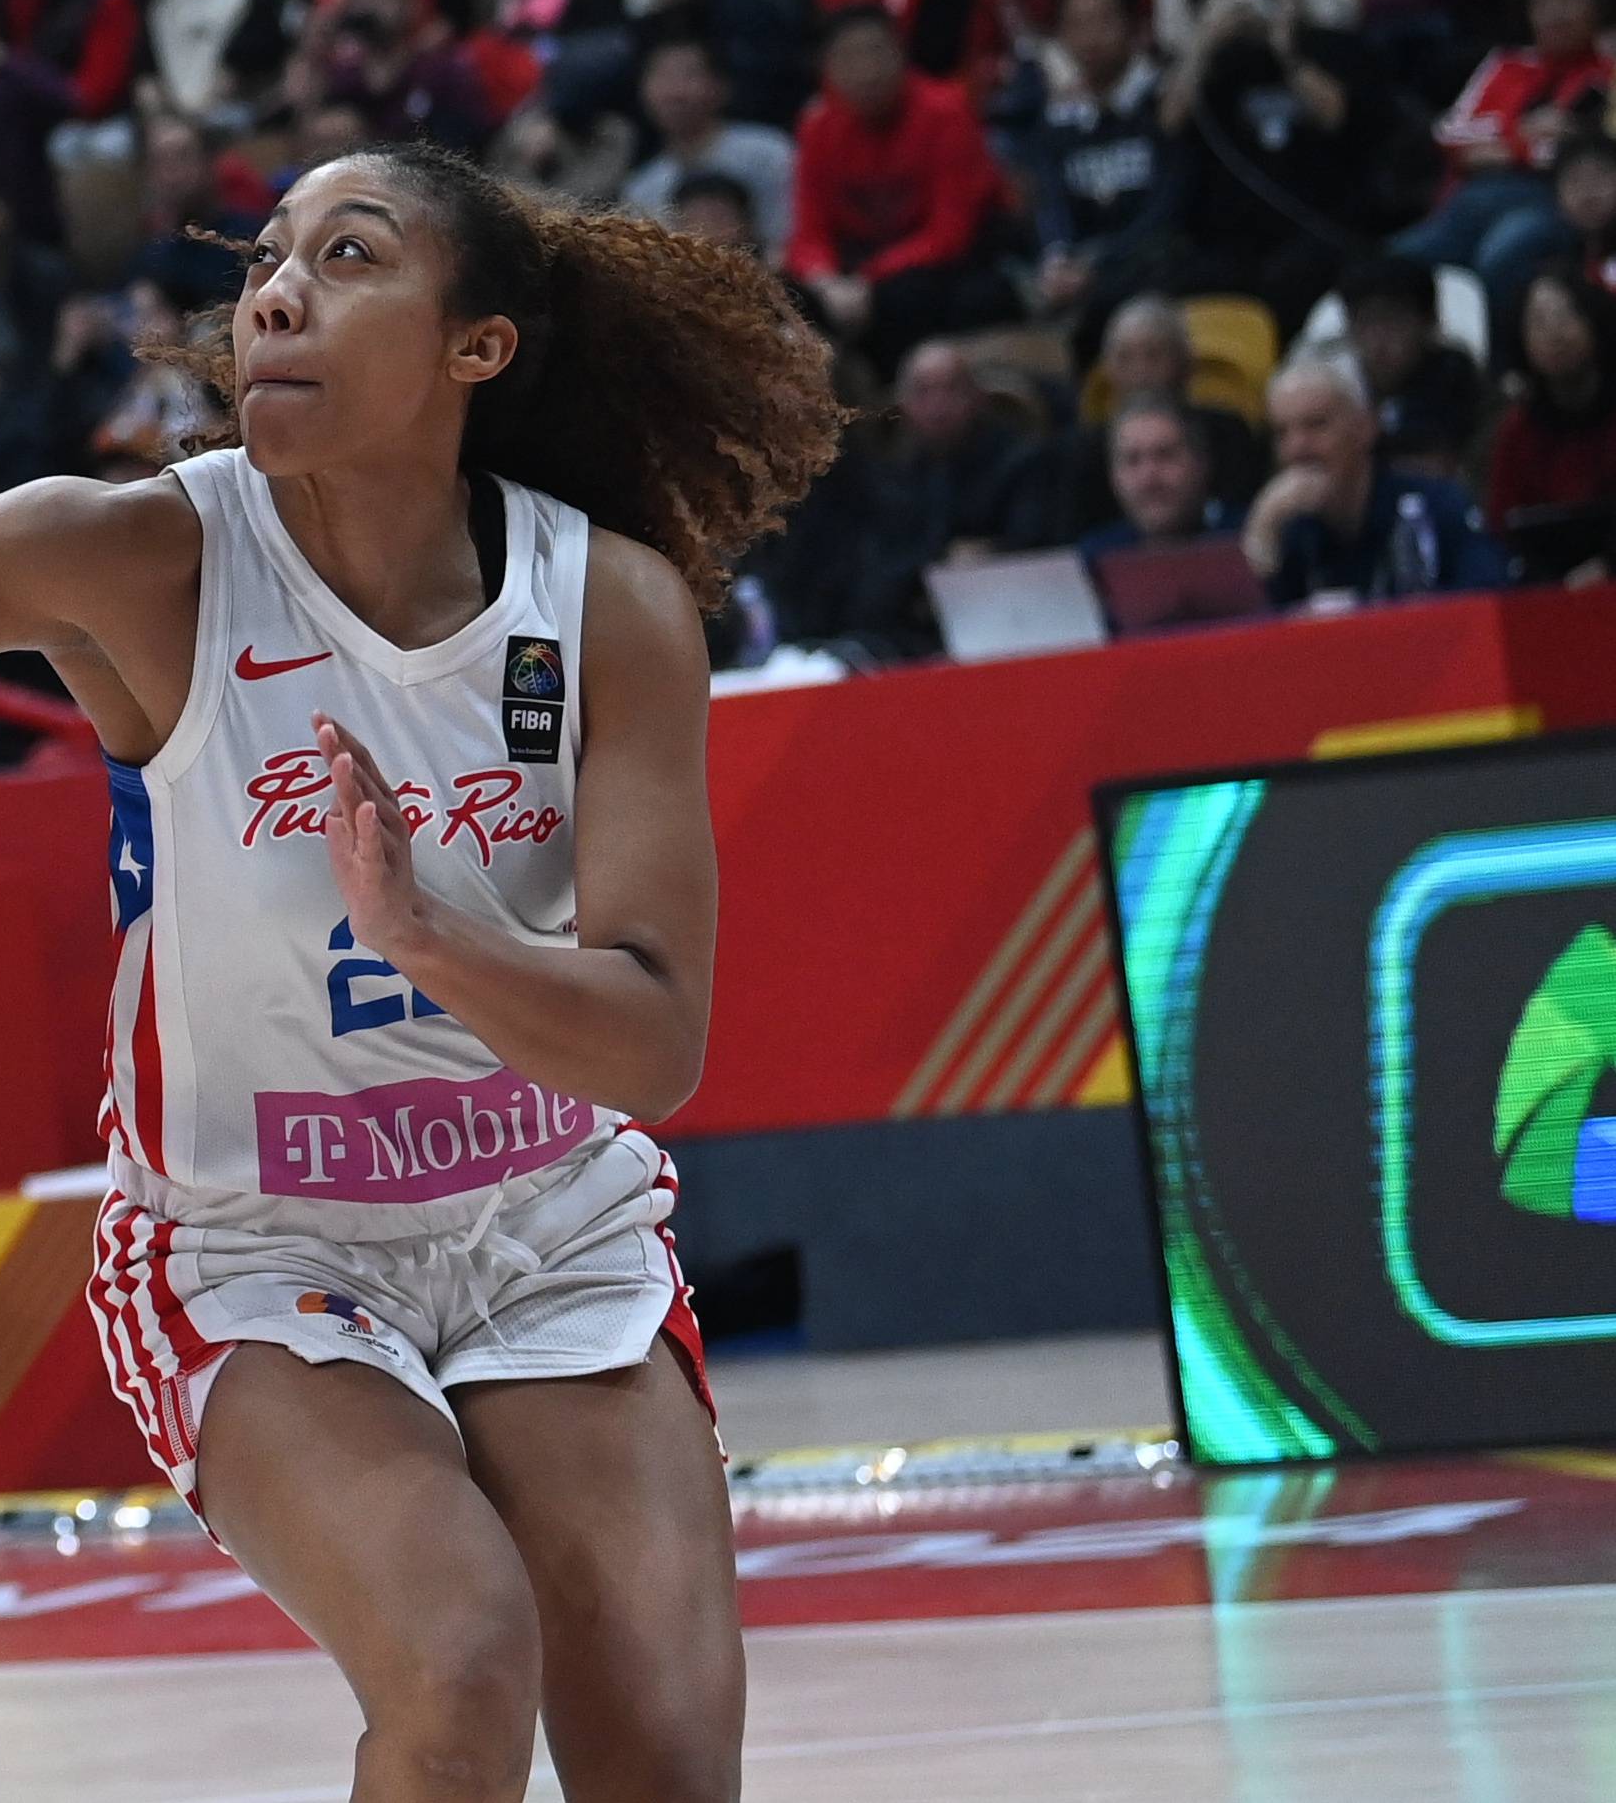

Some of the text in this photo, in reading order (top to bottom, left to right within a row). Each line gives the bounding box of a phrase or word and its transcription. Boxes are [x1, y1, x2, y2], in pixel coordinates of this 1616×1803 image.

[510, 709, 552, 731] FIBA
[439, 770, 565, 868] Rico
[327, 915, 448, 1038] 2
